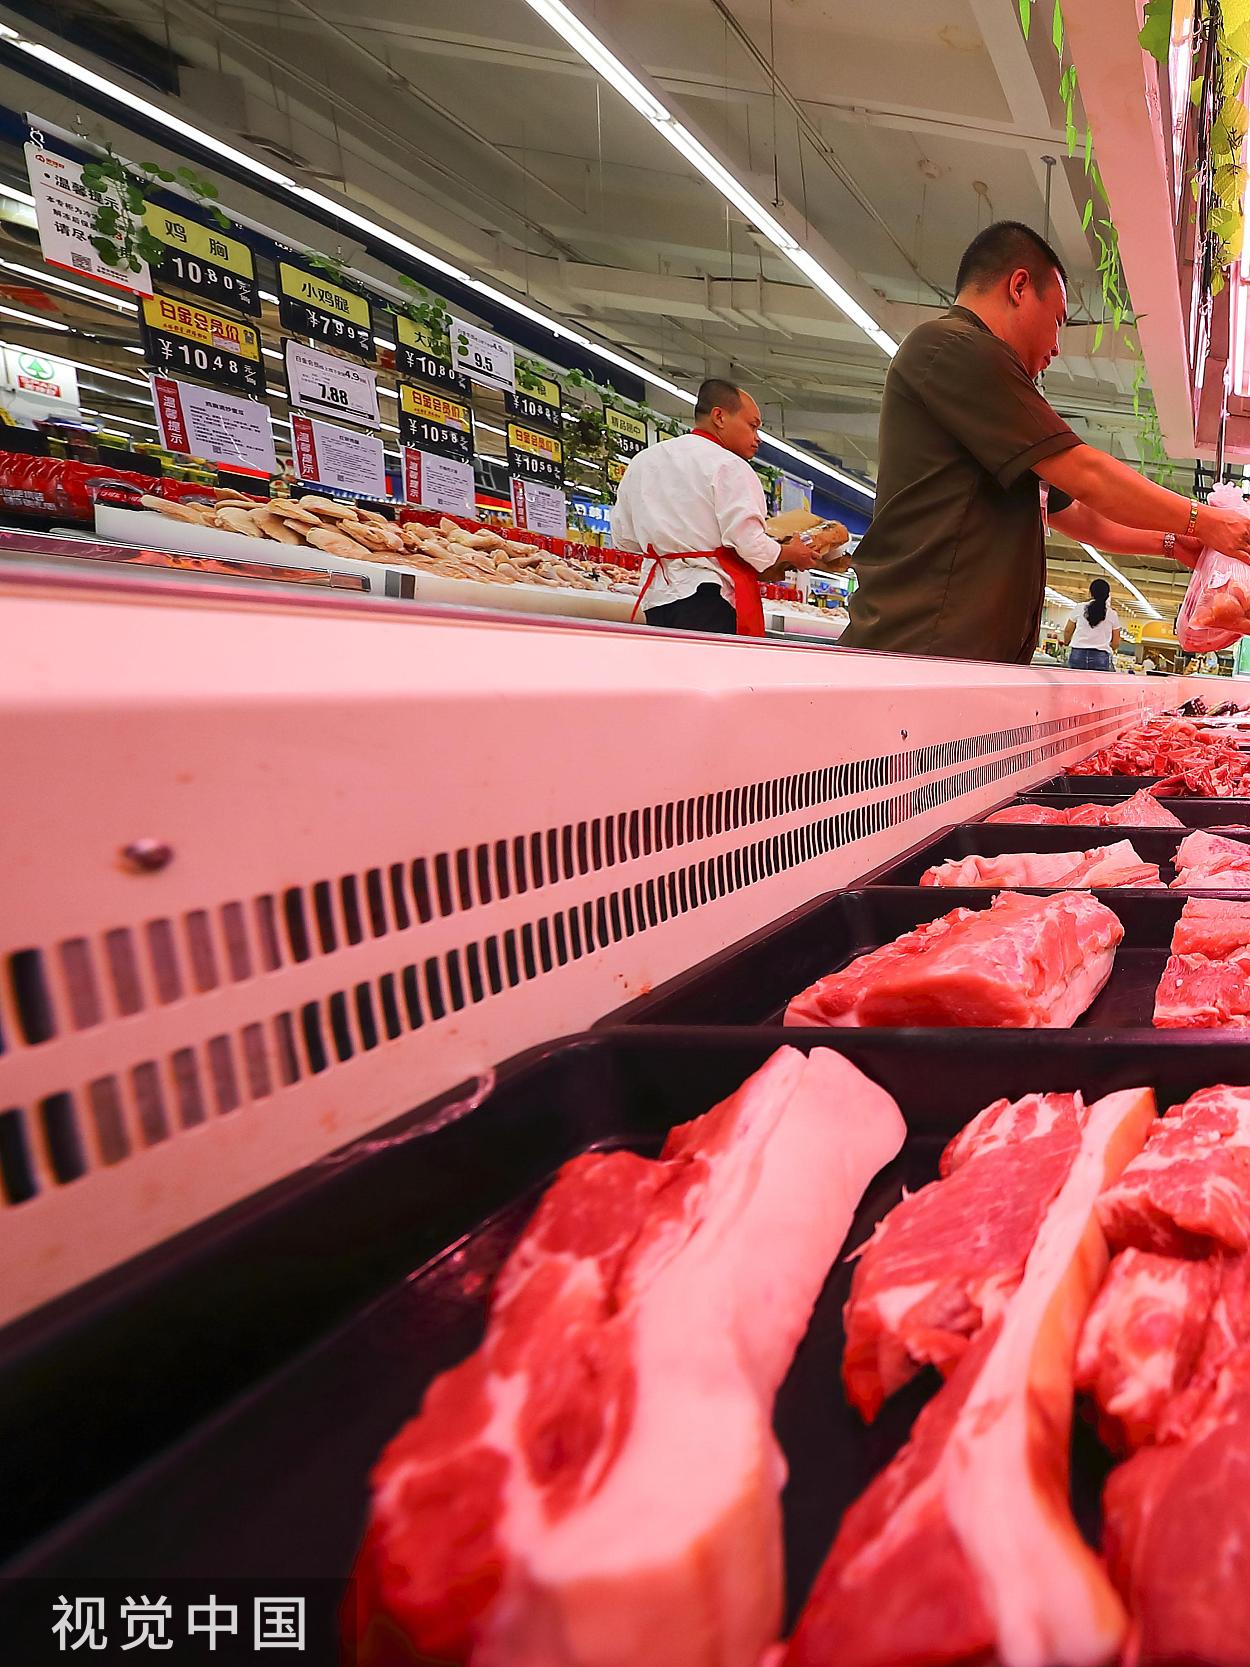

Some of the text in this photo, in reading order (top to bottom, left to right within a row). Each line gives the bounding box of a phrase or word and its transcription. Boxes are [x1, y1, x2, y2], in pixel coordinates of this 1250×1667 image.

[301, 282, 350, 314] 小鸡腿
[474, 352, 493, 373] 9.5
[318, 382, 349, 406] 7.88
